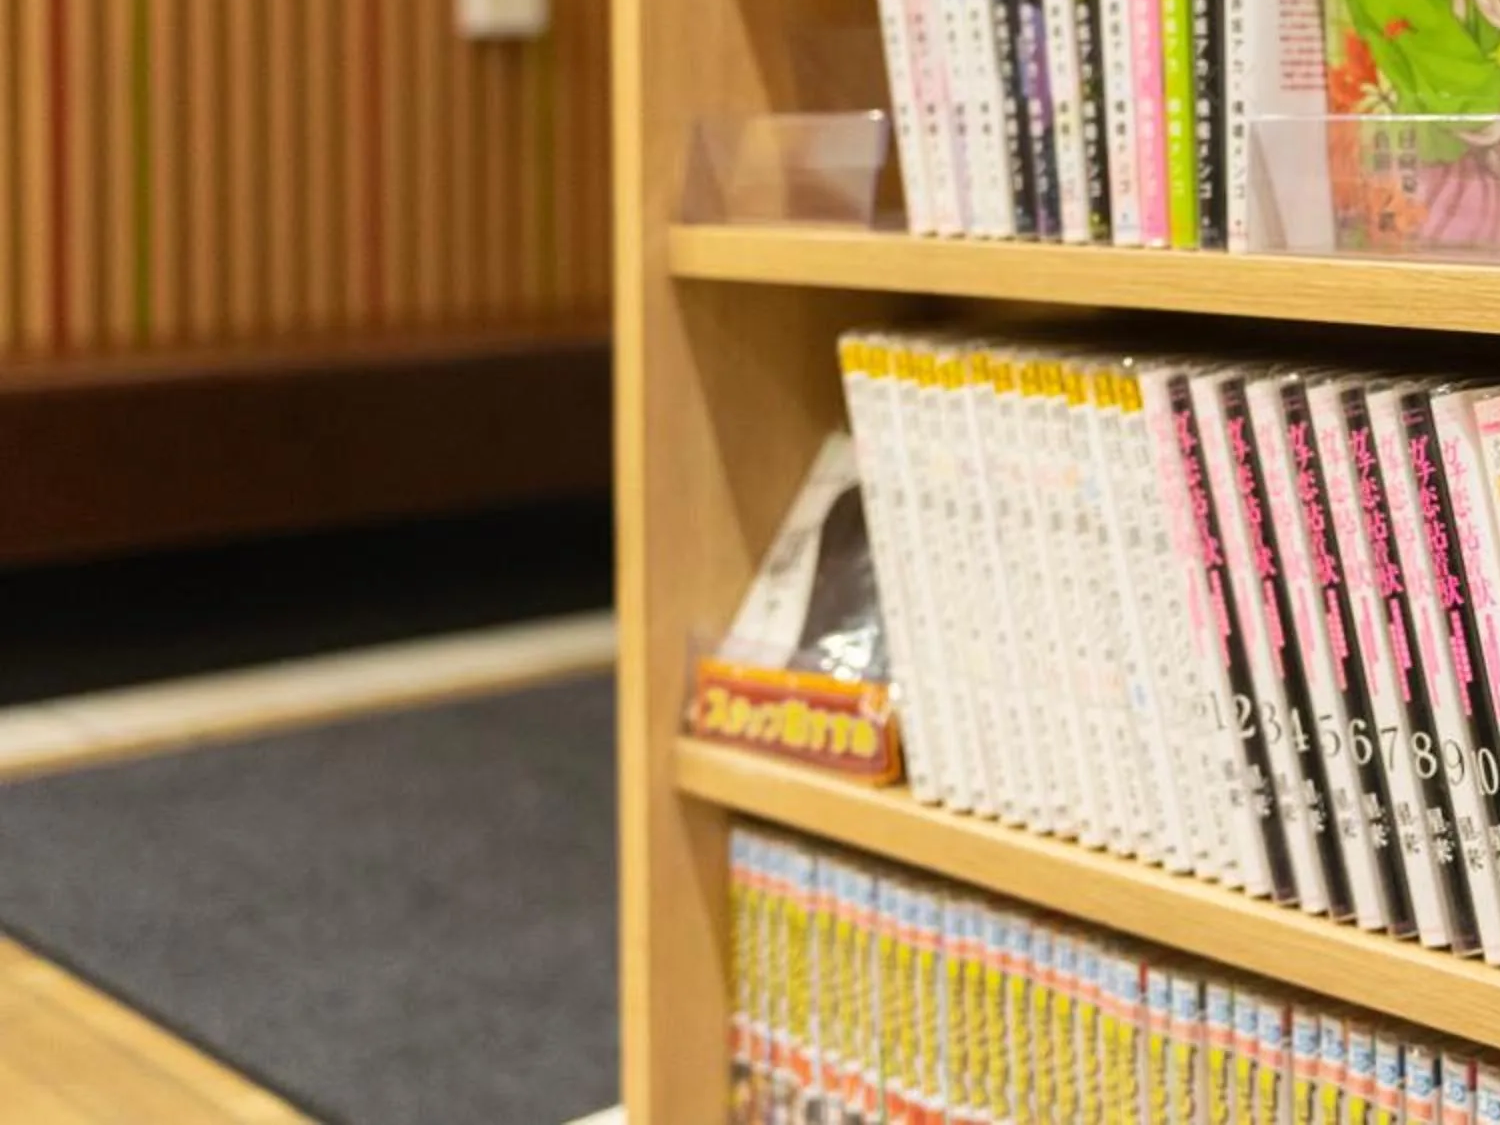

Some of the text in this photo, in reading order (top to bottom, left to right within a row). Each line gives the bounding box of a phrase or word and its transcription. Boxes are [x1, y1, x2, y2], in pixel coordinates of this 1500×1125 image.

[1235, 693, 1257, 739] 2
[1348, 718, 1373, 766] 6
[1410, 731, 1438, 780] 8
[1443, 738, 1465, 786] 9
[1473, 747, 1499, 796] 10
